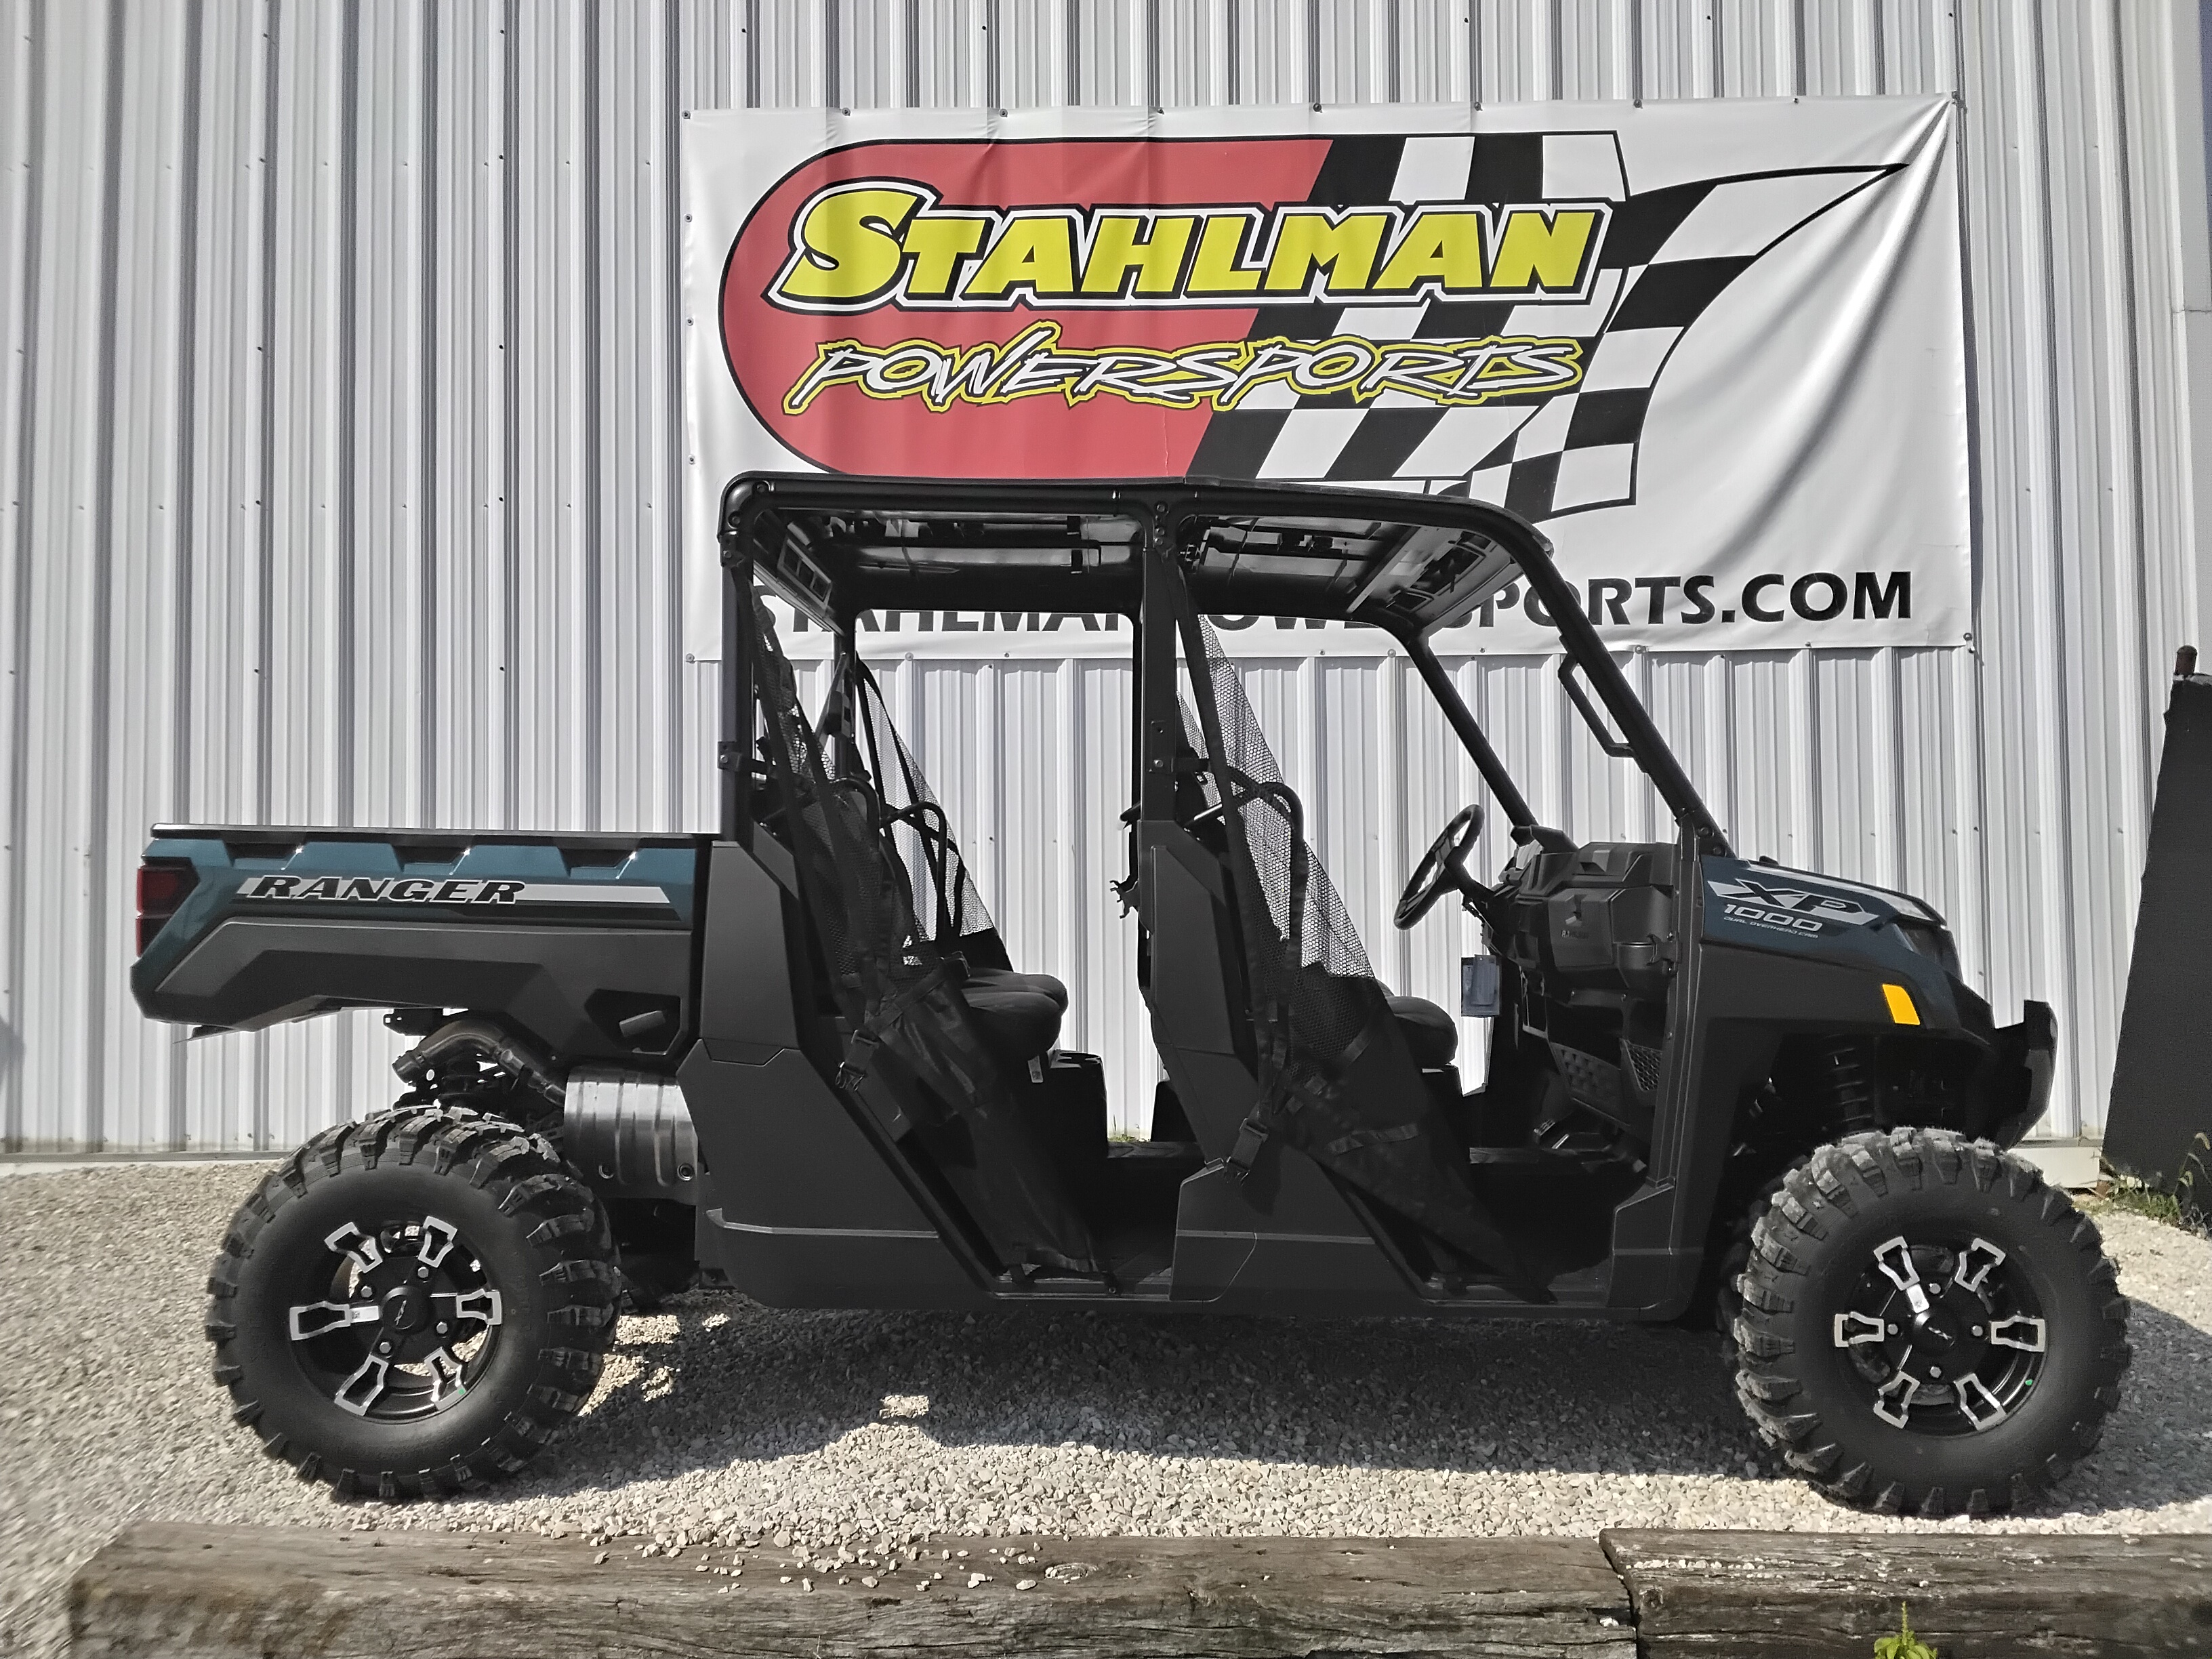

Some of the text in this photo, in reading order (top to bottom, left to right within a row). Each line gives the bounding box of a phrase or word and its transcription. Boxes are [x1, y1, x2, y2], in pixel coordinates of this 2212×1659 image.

[774, 184, 1605, 302] STAHLMAN
[783, 324, 1586, 412] POWERSPORTS
[248, 875, 526, 905] RANGER
[1718, 878, 1866, 915] XP
[1724, 904, 1823, 932] 1000
